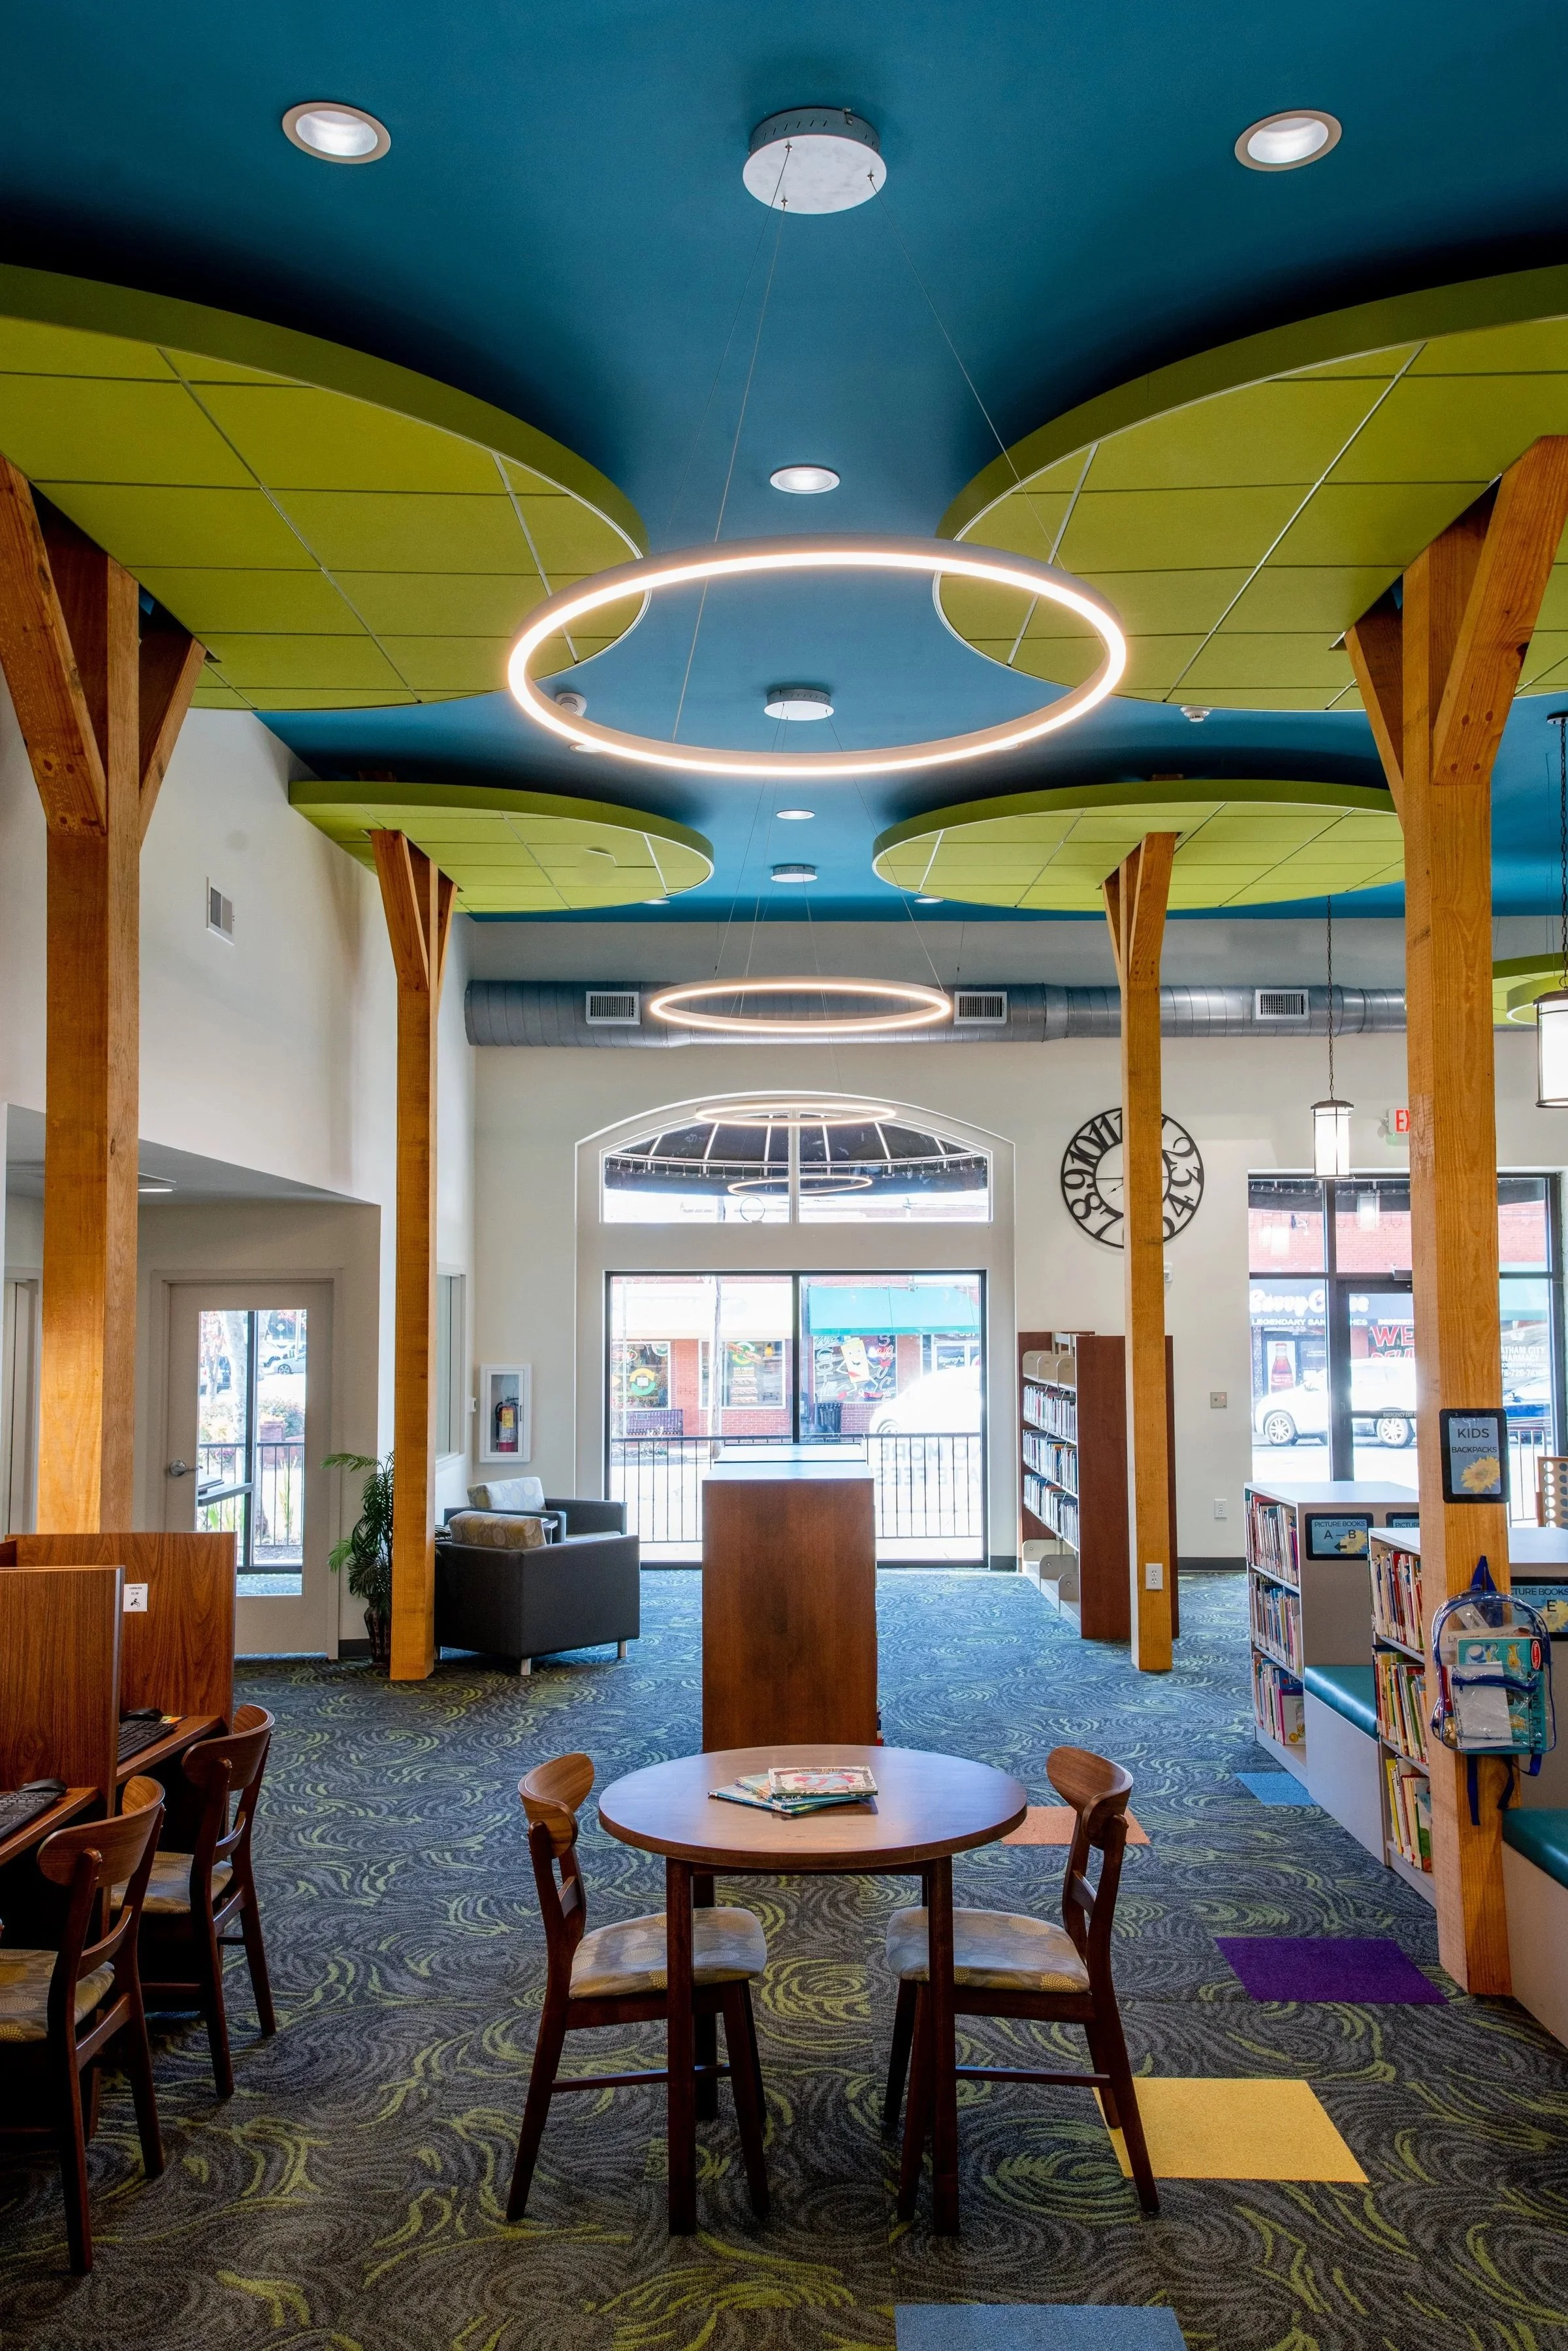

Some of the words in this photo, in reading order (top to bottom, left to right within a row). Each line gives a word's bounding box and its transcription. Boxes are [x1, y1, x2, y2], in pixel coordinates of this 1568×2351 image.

[1067, 1135, 1104, 1169] 10
[1162, 1136, 1196, 1164] 2
[1063, 1168, 1095, 1189] 9
[1170, 1166, 1204, 1187] 3
[1071, 1192, 1103, 1220] 8
[1167, 1192, 1198, 1217] 4
[1094, 1208, 1124, 1239] 7
[1528, 1346, 1545, 1354] CITY
[1458, 1428, 1490, 1438] KIDS
[1324, 1530, 1333, 1539] A
[1349, 1529, 1356, 1539] B
[1547, 1599, 1556, 1612] E
